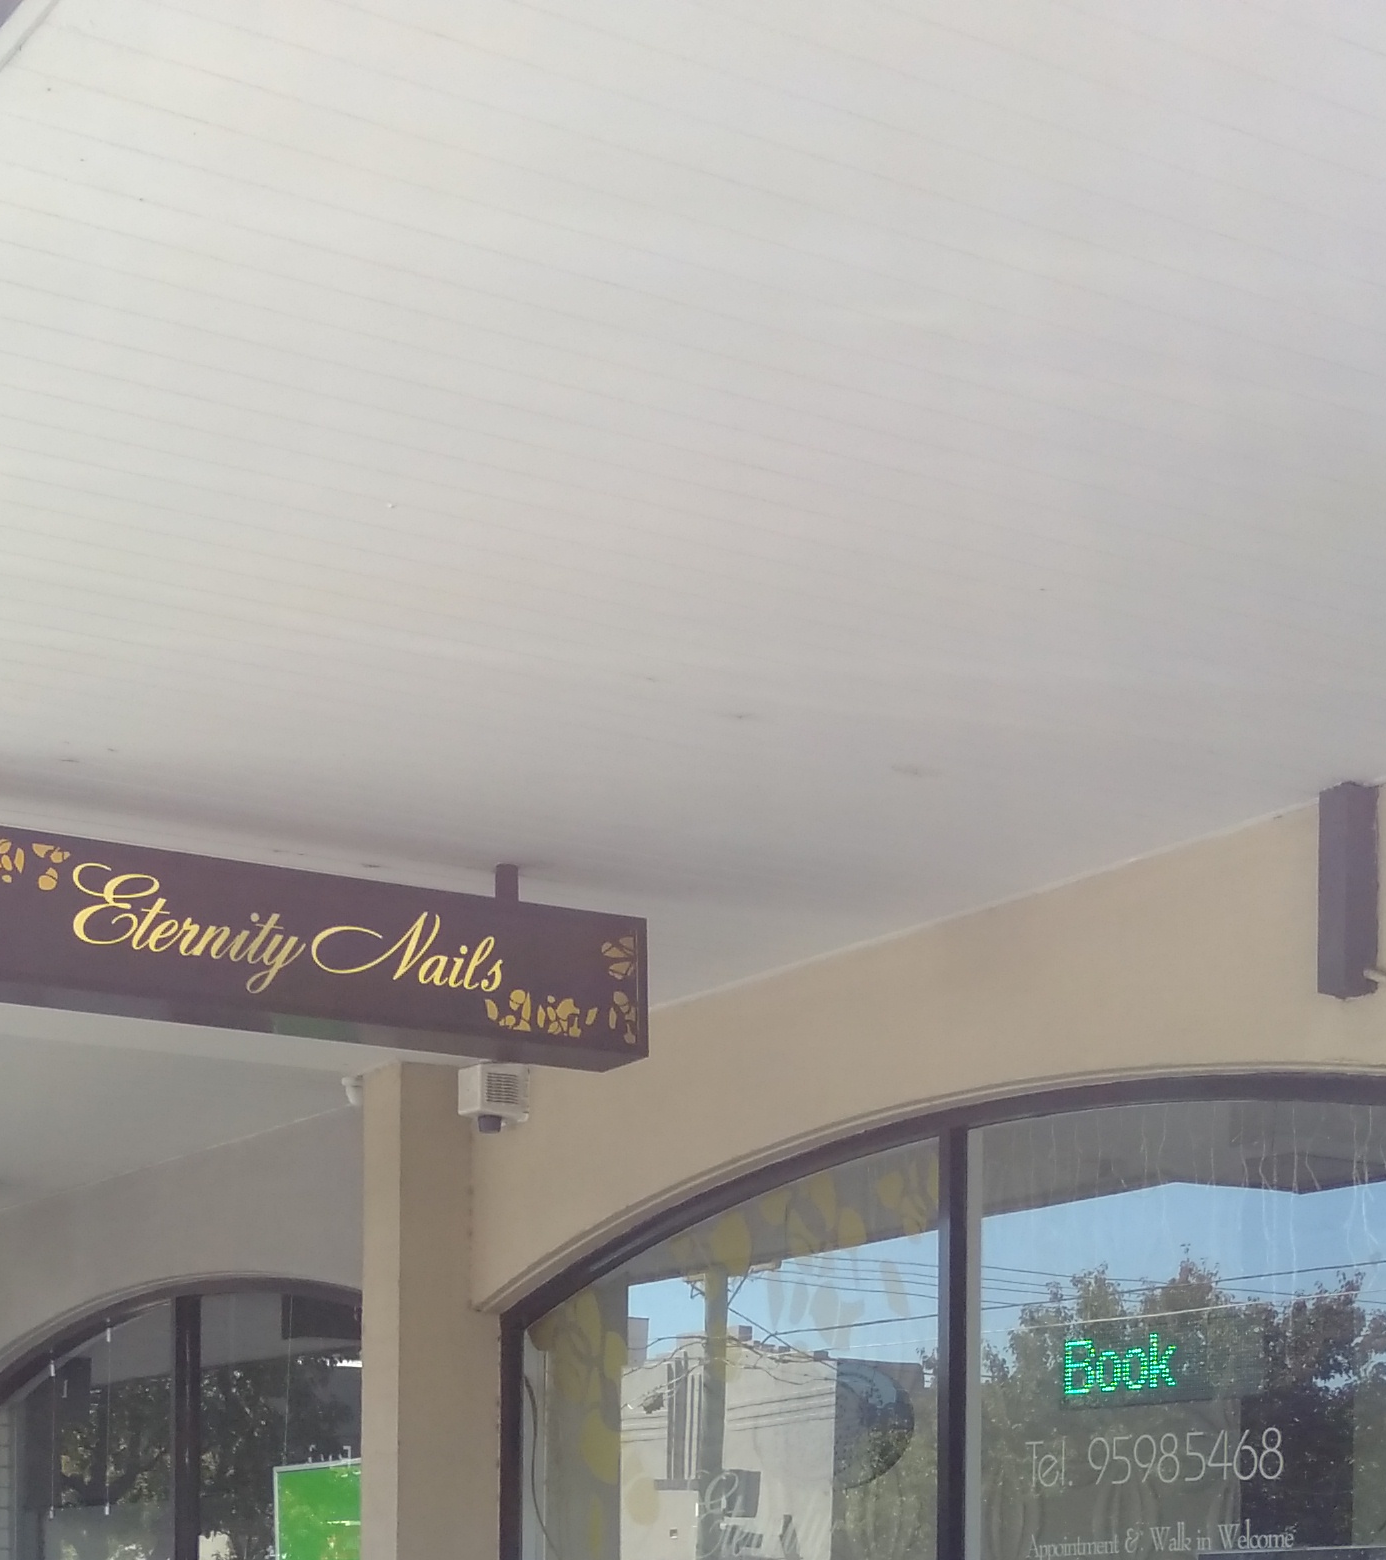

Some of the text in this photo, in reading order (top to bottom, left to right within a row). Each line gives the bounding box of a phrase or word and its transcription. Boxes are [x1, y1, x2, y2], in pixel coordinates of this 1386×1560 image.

[71, 861, 505, 994] Eternity Nails
[1064, 1331, 1177, 1395] Book
[1024, 1426, 1285, 1487] Tel. 95985468
[1149, 1521, 1192, 1552] Walk
[1196, 1530, 1212, 1551] in
[1217, 1518, 1294, 1550] Welcome
